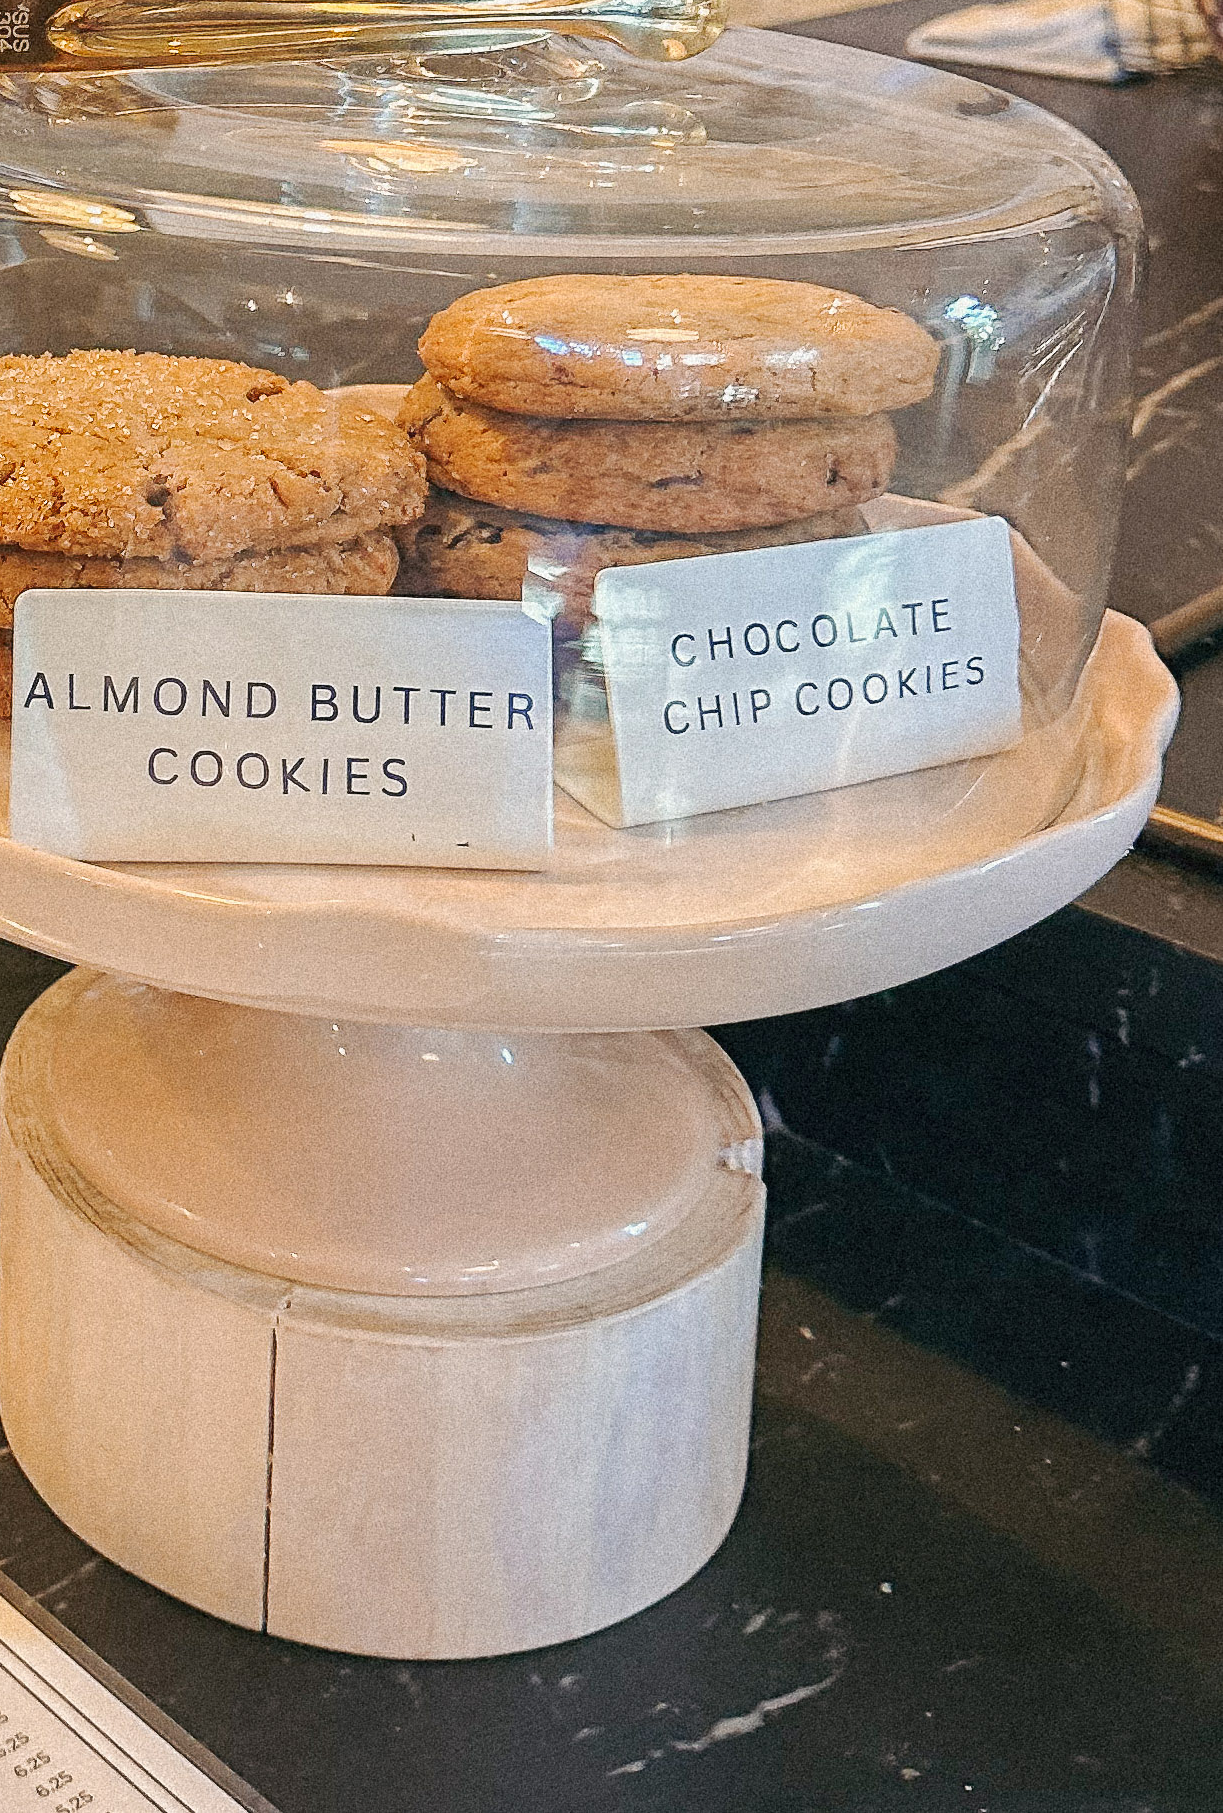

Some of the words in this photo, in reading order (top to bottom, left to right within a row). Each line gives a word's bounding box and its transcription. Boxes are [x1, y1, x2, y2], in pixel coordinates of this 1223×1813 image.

[12, 11, 30, 52] SUS
[670, 596, 953, 668] CHOCOLATE
[23, 671, 278, 720] ALMOND
[309, 684, 535, 731] BUTTER
[663, 688, 772, 735] CHIP
[794, 655, 986, 716] COOKIES
[147, 746, 410, 798] COOKIES
[13, 1751, 50, 1777] 6.25
[35, 1771, 73, 1797] 6.25
